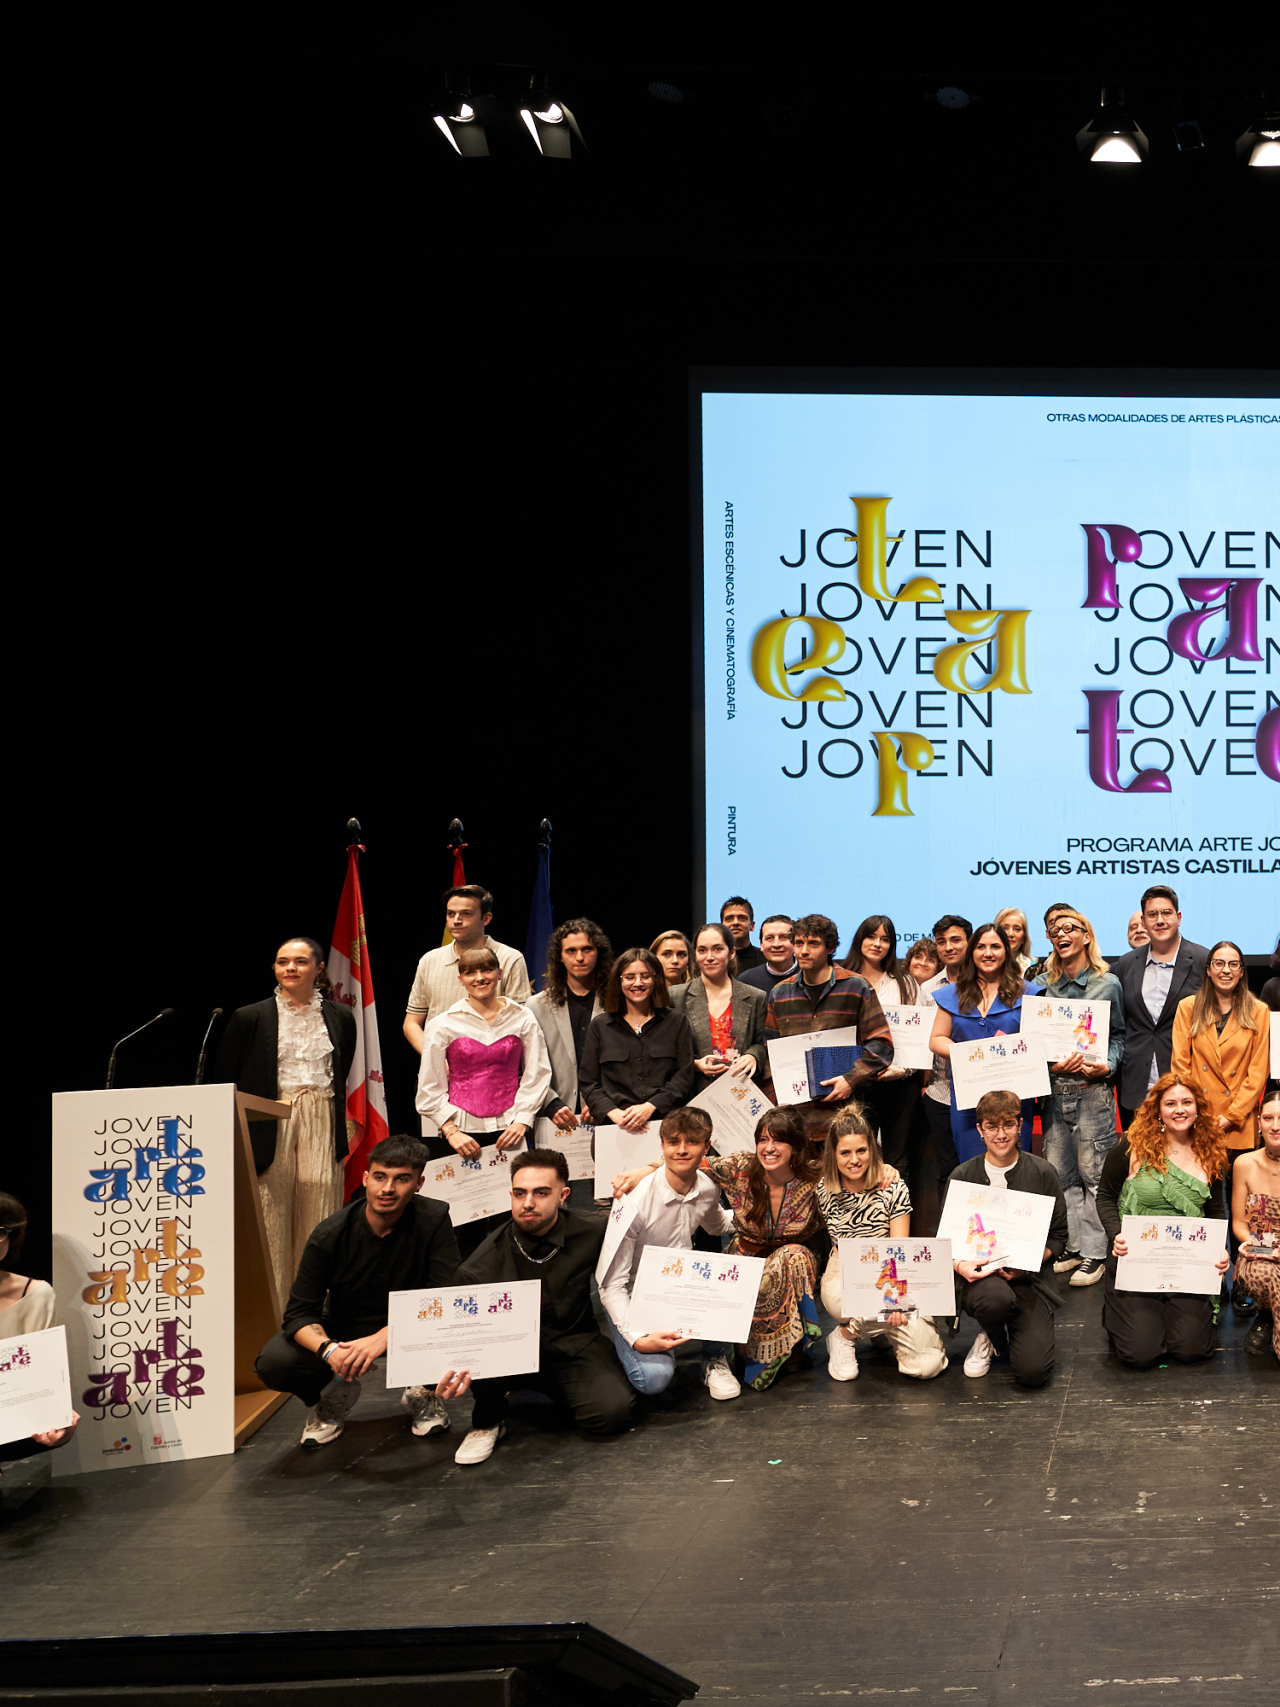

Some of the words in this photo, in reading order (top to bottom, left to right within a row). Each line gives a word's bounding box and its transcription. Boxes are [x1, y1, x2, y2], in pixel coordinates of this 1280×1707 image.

[1046, 413, 1086, 423] OTRAS
[1088, 414, 1169, 424] MODALIDADES
[1170, 414, 1186, 423] DE
[1187, 414, 1225, 424] ARTES
[724, 500, 734, 538] ARTES
[724, 540, 737, 606] ESCÉNICAS
[725, 608, 735, 616] Y
[725, 618, 738, 721] CINEMATOGRAFÍA
[727, 805, 737, 856] PINTURA
[1066, 836, 1194, 853] PROGRAMA
[1198, 836, 1253, 852] ARTE
[969, 856, 1072, 876] JÓVENES
[1075, 858, 1181, 875] ARTISTAS
[903, 933, 920, 942] DE
[94, 1196, 192, 1216] JOVEN
[93, 1296, 191, 1318] JOVEN
